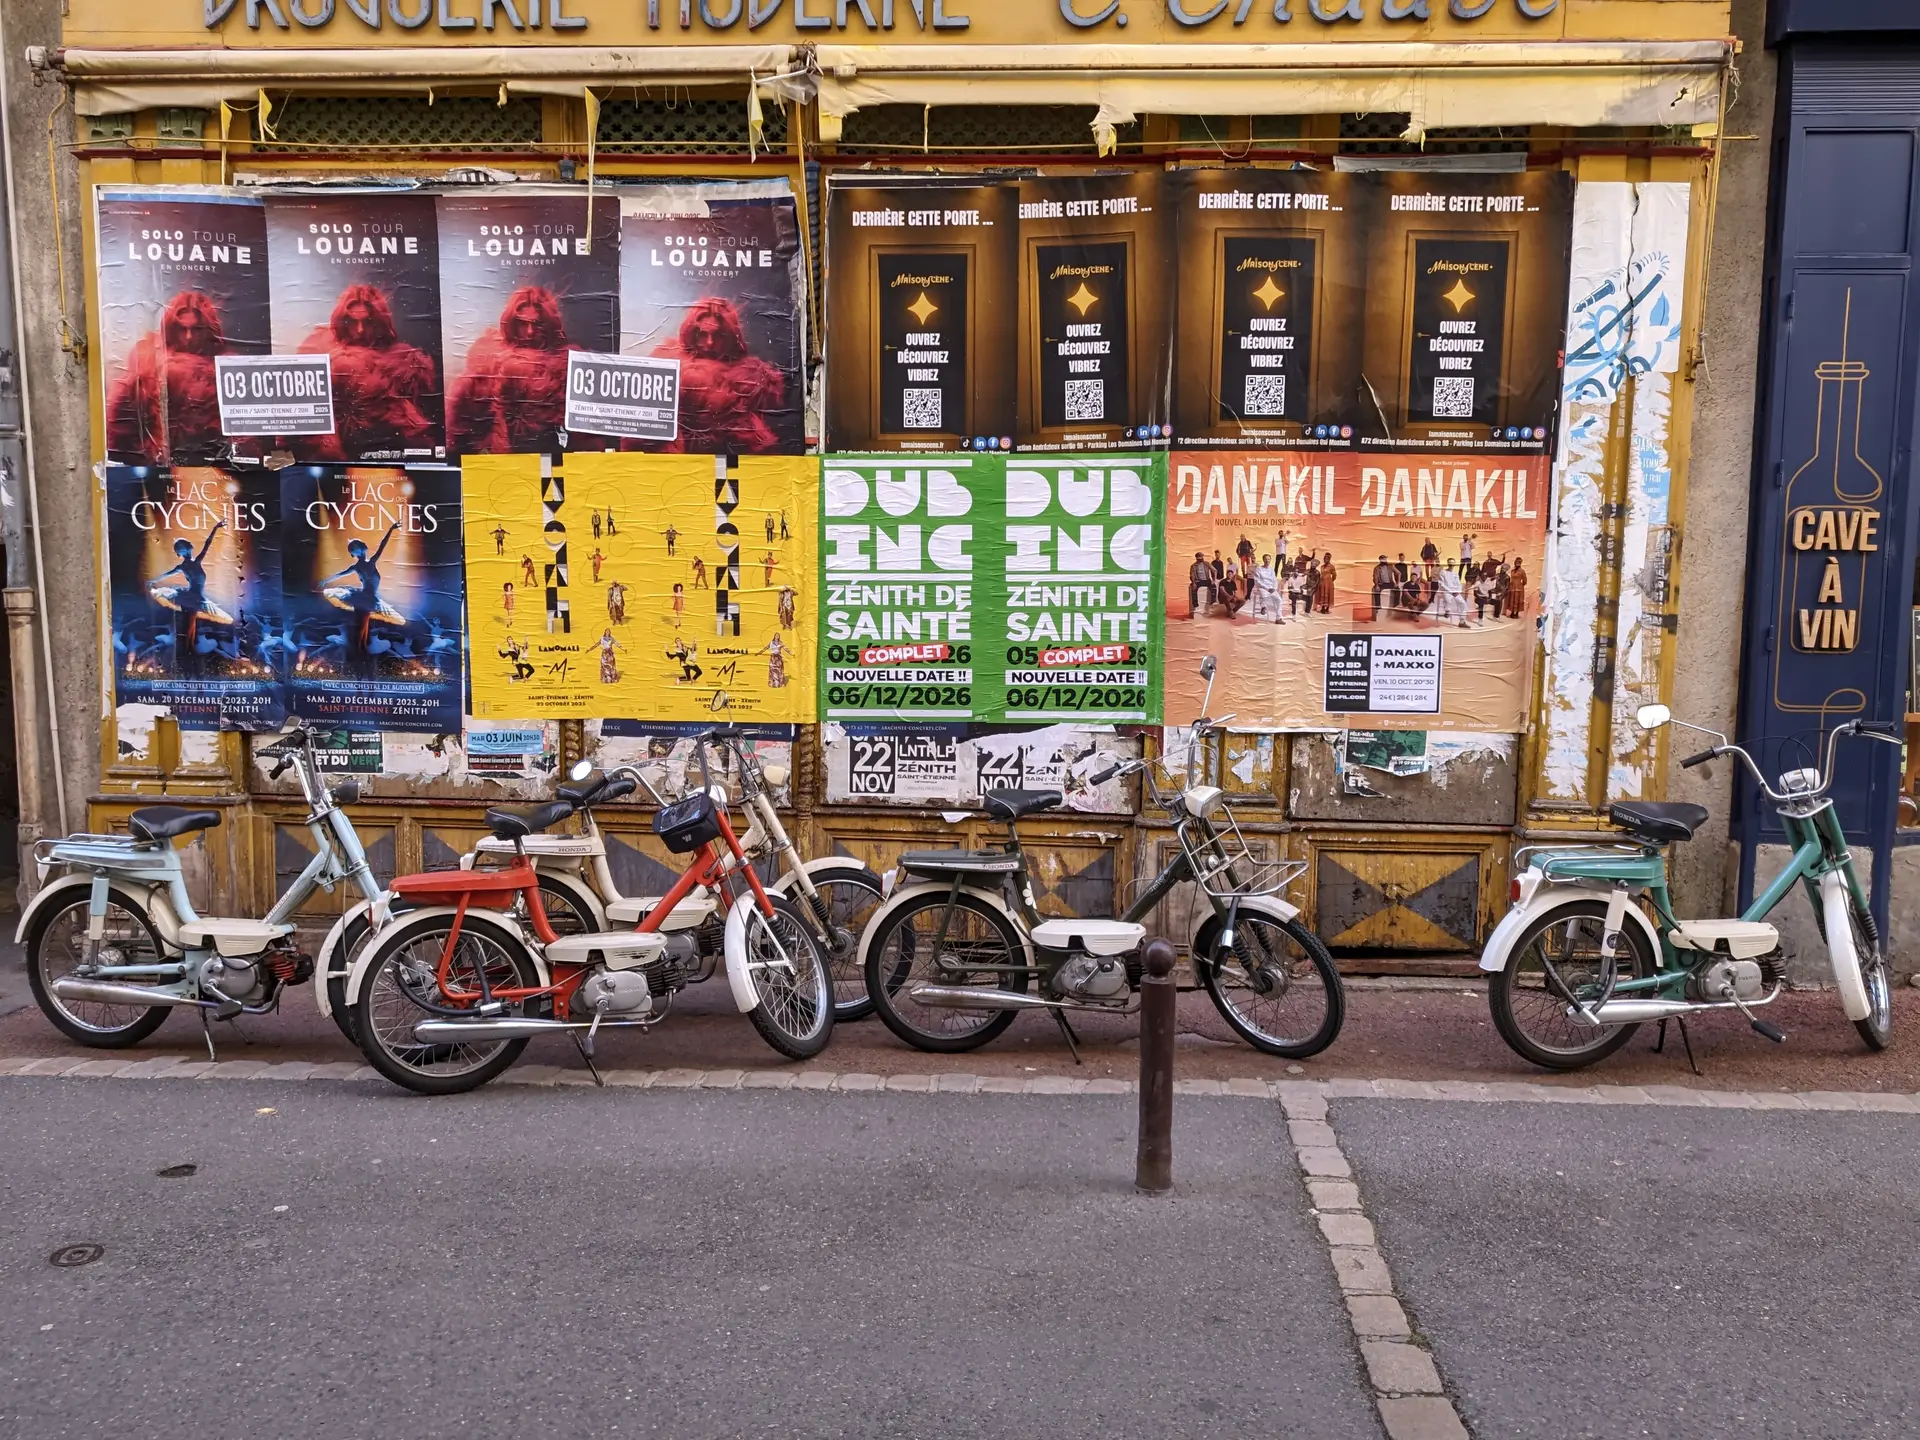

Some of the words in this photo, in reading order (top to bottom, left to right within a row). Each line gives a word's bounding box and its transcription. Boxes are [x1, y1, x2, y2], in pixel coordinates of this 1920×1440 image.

[1018, 199, 1063, 219] ERRIÈRE
[1065, 199, 1099, 217] CETTE
[1101, 196, 1138, 215] PORTE
[1198, 189, 1254, 210] DERRIÈRE
[1256, 193, 1292, 209] CETTE
[1295, 193, 1329, 211] PORTE
[1390, 191, 1446, 212] DERRIÈRE
[1448, 194, 1484, 213] CETTE
[1486, 195, 1525, 213] PORTE
[852, 207, 905, 227] DERRIÈRE
[908, 210, 941, 226] CETTE
[944, 210, 979, 226] PORTE
[142, 230, 184, 241] SOLO
[192, 231, 237, 243] TOUR
[309, 223, 352, 234] SOLO
[362, 223, 404, 234] TOUR
[480, 224, 524, 235] SOLO
[533, 224, 575, 236] TOUR
[297, 237, 418, 255] LOUANE
[467, 238, 590, 256] LOUANE
[664, 236, 708, 247] SOLO
[717, 236, 759, 247] TOUR
[129, 243, 251, 265] LOUANE
[651, 249, 773, 267] LOUANE
[698, 270, 740, 278] CONCERT
[1066, 323, 1102, 337] OUVREZ
[1249, 318, 1287, 332] OUVREZ
[1439, 320, 1476, 335] OUVREZ
[905, 332, 941, 346] OUVREZ
[1057, 340, 1111, 356] DÉCOUVREZ
[1240, 333, 1294, 350] DÉCOUVREZ
[1429, 336, 1484, 353] DÉCOUVREZ
[897, 348, 949, 364] DÉCOUVREZ
[1249, 354, 1283, 368] VIBREZ
[1439, 356, 1472, 370] VIBREZ
[907, 368, 939, 382] VIBREZ
[1068, 359, 1101, 373] VIBREZ
[224, 371, 247, 399] 03
[251, 370, 326, 398] OCTOBRE
[573, 367, 595, 396] 03
[600, 370, 674, 402] OCTOBRE
[176, 481, 218, 501] LAC
[341, 485, 350, 494] Le
[351, 481, 395, 503] LAC
[824, 470, 973, 517] DUB
[1005, 470, 1152, 517] DUB
[1176, 465, 1346, 515] DANAKIL
[1360, 467, 1537, 519] DANAKIL
[131, 500, 266, 532] CYGNES
[305, 500, 438, 533] CYGNES
[1215, 518, 1241, 526] NOUVEL
[1244, 518, 1269, 526] ALBUM
[1399, 521, 1427, 529] NOUVEL
[1429, 521, 1454, 530] ALBUM
[1455, 522, 1497, 531] DISPONIBLE
[1792, 510, 1881, 552] CAVE
[825, 524, 973, 571] INC
[1005, 524, 1152, 571] INC
[1817, 556, 1843, 604] À
[826, 581, 925, 606] ZÉNITH
[935, 585, 972, 606] DE
[1006, 581, 1114, 607] ZÉNITH
[1117, 587, 1149, 607] DE
[826, 605, 972, 641] SAINTÉ
[1006, 606, 1149, 642] SAINTÉ
[1799, 608, 1857, 649] VIN
[864, 644, 944, 665] COMPLET
[1043, 645, 1125, 665] COMPLET
[1329, 640, 1346, 657] le
[1348, 639, 1368, 657] fil
[1374, 649, 1436, 657] DANAKIL
[1383, 661, 1435, 669] MAXXO
[832, 669, 913, 683] NOUVELLE
[916, 670, 955, 683] DATE
[1011, 671, 1092, 684] NOUVELLE
[1095, 672, 1136, 684] DATE
[137, 695, 158, 704] SAM.
[161, 695, 172, 704] 20
[174, 693, 222, 705] DÉCEMBRE
[252, 696, 271, 705] 20H
[306, 696, 328, 704] SAM.
[330, 696, 341, 704] 20
[344, 694, 394, 706] DÉCEMBRE
[421, 699, 440, 707] 20H
[827, 686, 972, 708] 06/12/2026
[1006, 687, 1146, 709] 06/12/2026
[221, 704, 259, 714] ZÉNITH
[392, 706, 428, 716] ZÉNITH
[485, 733, 498, 743] 03
[500, 732, 522, 743] JUIN
[315, 755, 329, 766] ET
[331, 755, 349, 766] DU
[853, 742, 892, 772] 22
[897, 761, 956, 774] ZÉNITH
[852, 773, 894, 793] NOV
[896, 773, 957, 781] SAINT-ÉTIENNE
[1613, 810, 1642, 825] HONDA
